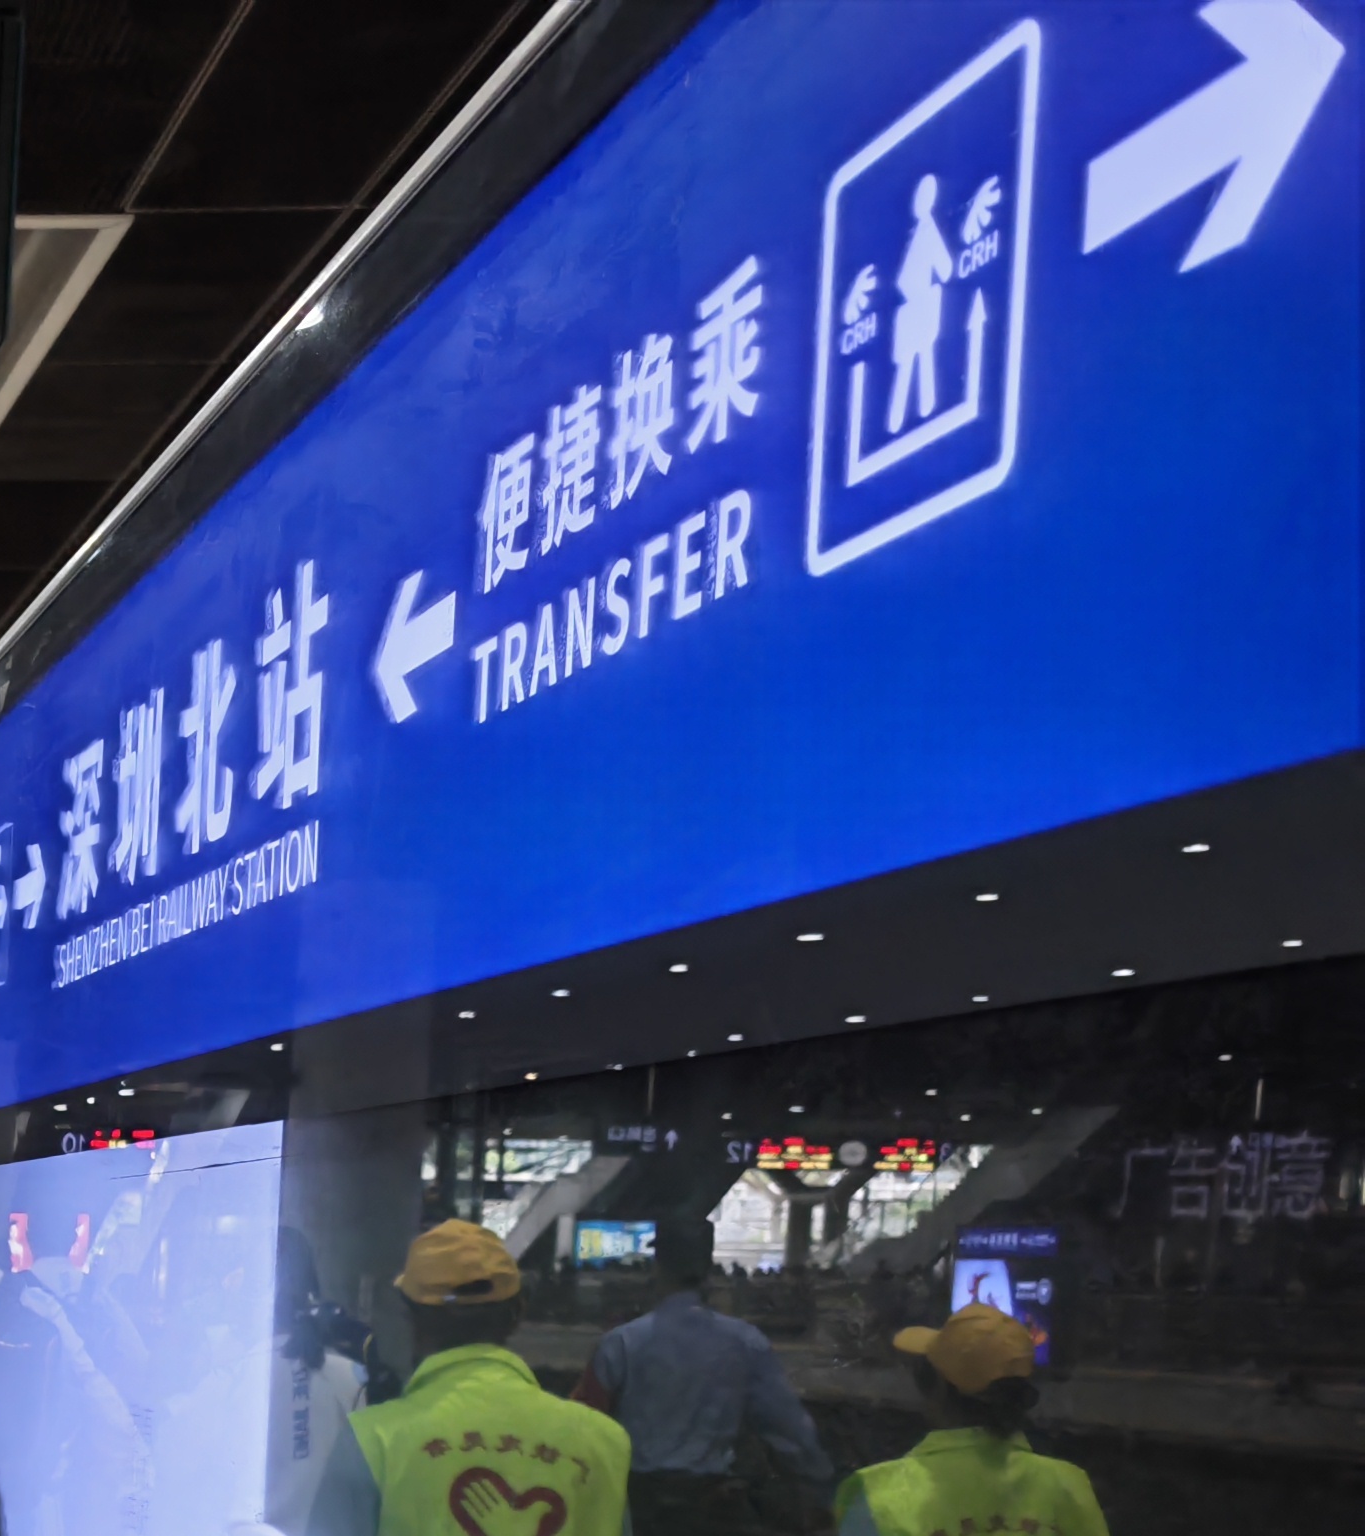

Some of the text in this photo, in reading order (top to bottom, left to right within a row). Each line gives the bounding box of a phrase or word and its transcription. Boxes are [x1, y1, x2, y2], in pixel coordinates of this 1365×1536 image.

[839, 311, 877, 355] CRH
[959, 229, 999, 279] CRH
[475, 254, 767, 598] 便捷换乘
[470, 488, 755, 726] TRANSFER
[57, 558, 331, 924] 深圳北站
[57, 906, 127, 989] SHENZHEN
[130, 900, 156, 957] BEI
[158, 863, 229, 946] RAILWAY
[231, 820, 320, 916] STATION
[1116, 1128, 1332, 1224] 广告创意
